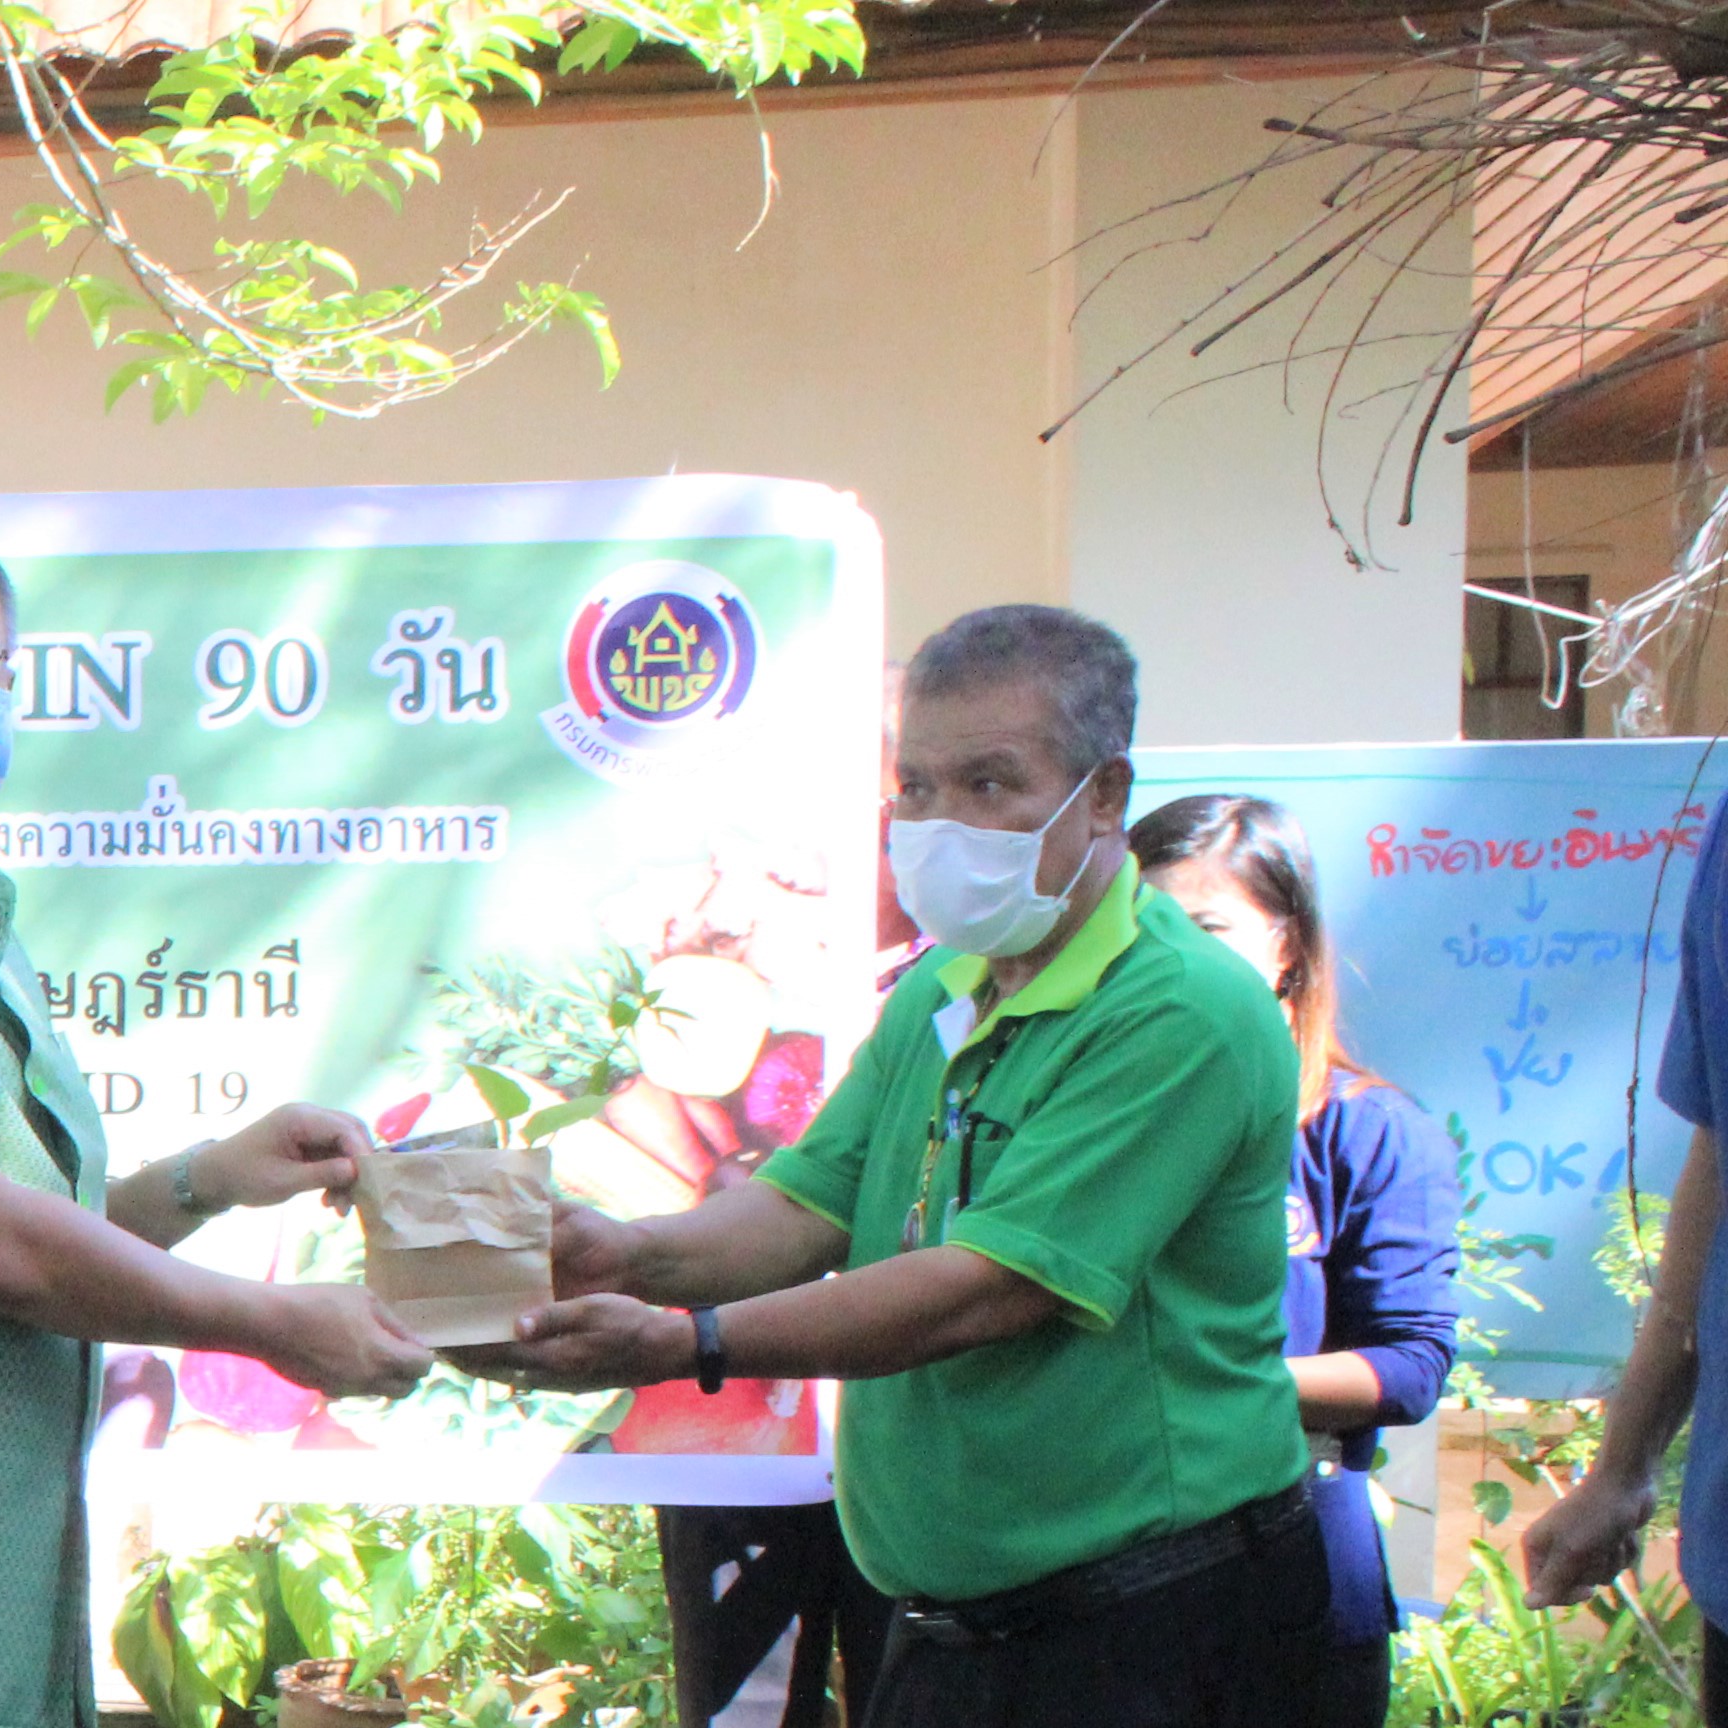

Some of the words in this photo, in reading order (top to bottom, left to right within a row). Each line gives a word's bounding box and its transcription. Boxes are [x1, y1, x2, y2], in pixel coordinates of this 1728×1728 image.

[20, 640, 142, 721] IN
[205, 638, 319, 721] 90
[381, 616, 498, 713] วัน
[36, 936, 300, 1037] ษฎร์ธานี
[188, 1070, 249, 1116] 19
